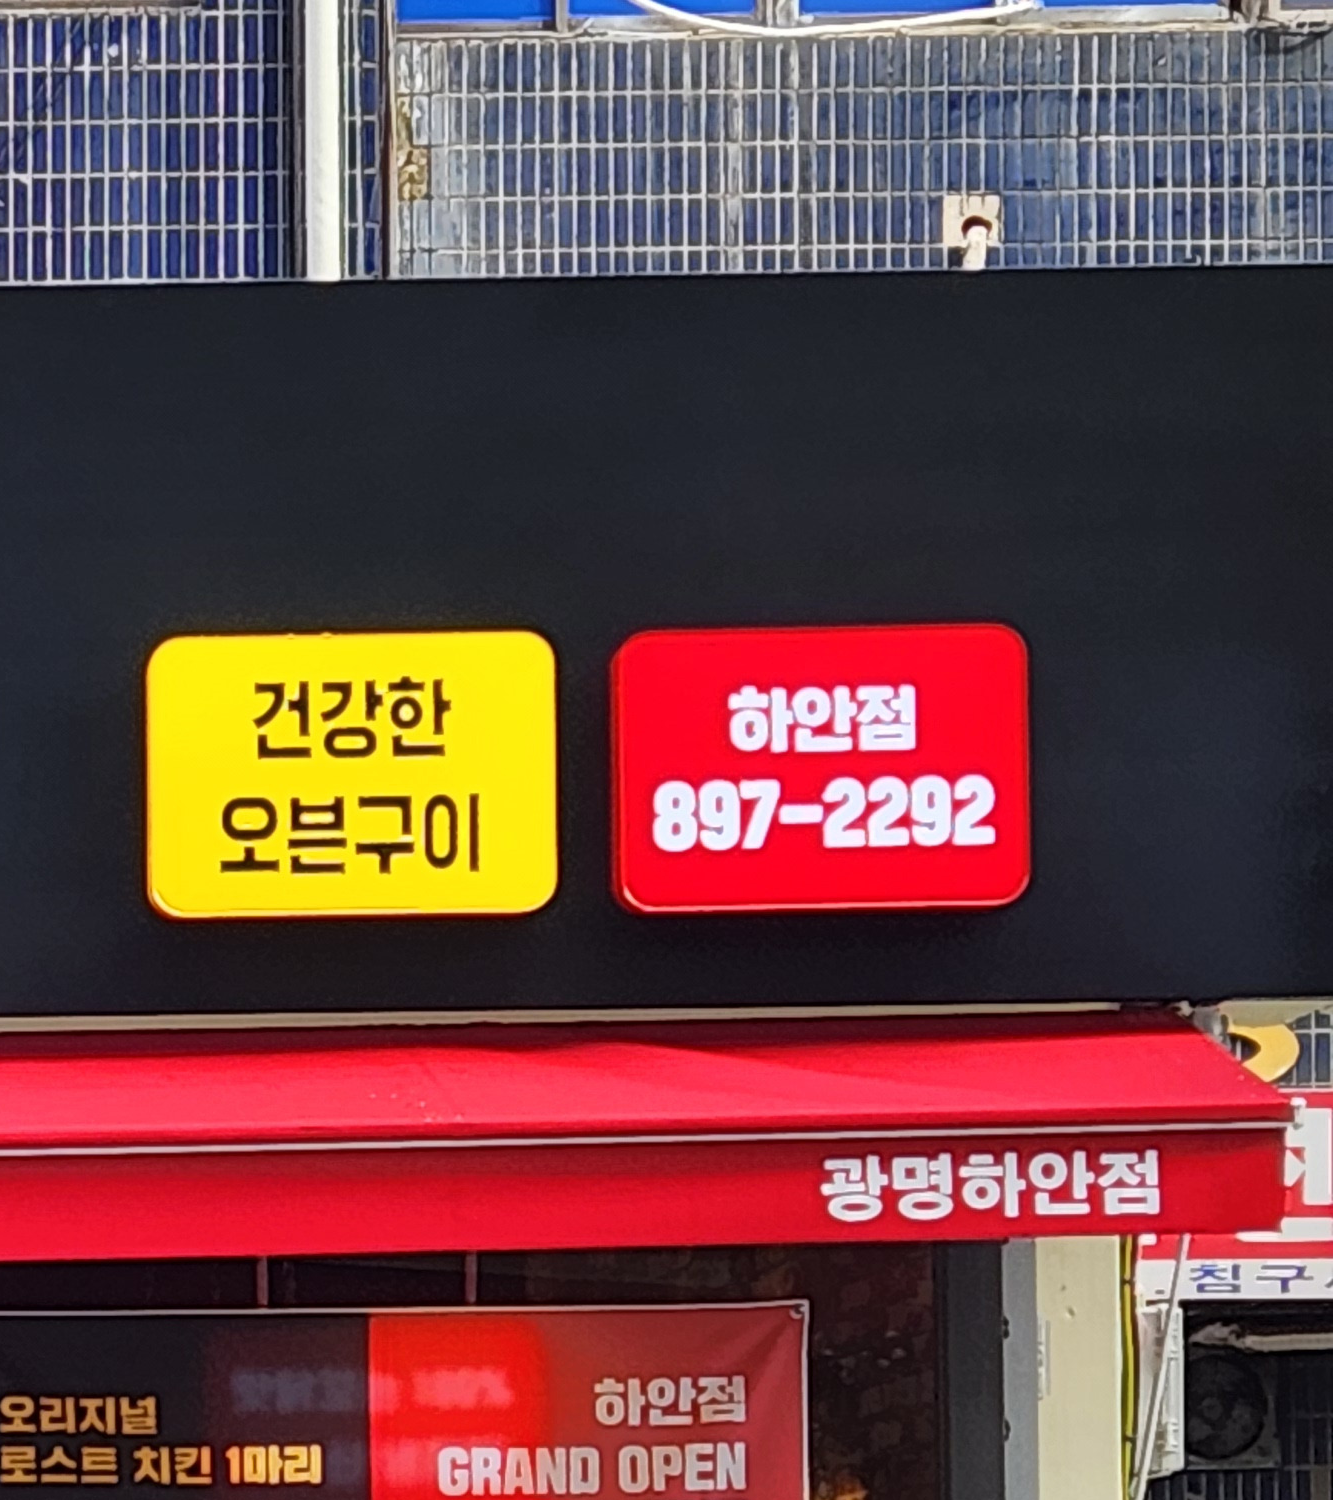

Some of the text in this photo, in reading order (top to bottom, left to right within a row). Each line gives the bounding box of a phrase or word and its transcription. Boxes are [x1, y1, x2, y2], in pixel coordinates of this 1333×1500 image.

[253, 678, 451, 760] 건강한
[728, 684, 917, 754] 하안점
[219, 792, 481, 875] 오븐구이
[651, 774, 996, 853] 897-2292
[819, 1149, 1162, 1223] 광명하안점
[1189, 1263, 1333, 1294] 침구
[593, 1375, 747, 1427] 하안점
[0, 1443, 323, 1486] 로스트 치킨 1마리
[437, 1441, 747, 1497] GRAND OPEN
